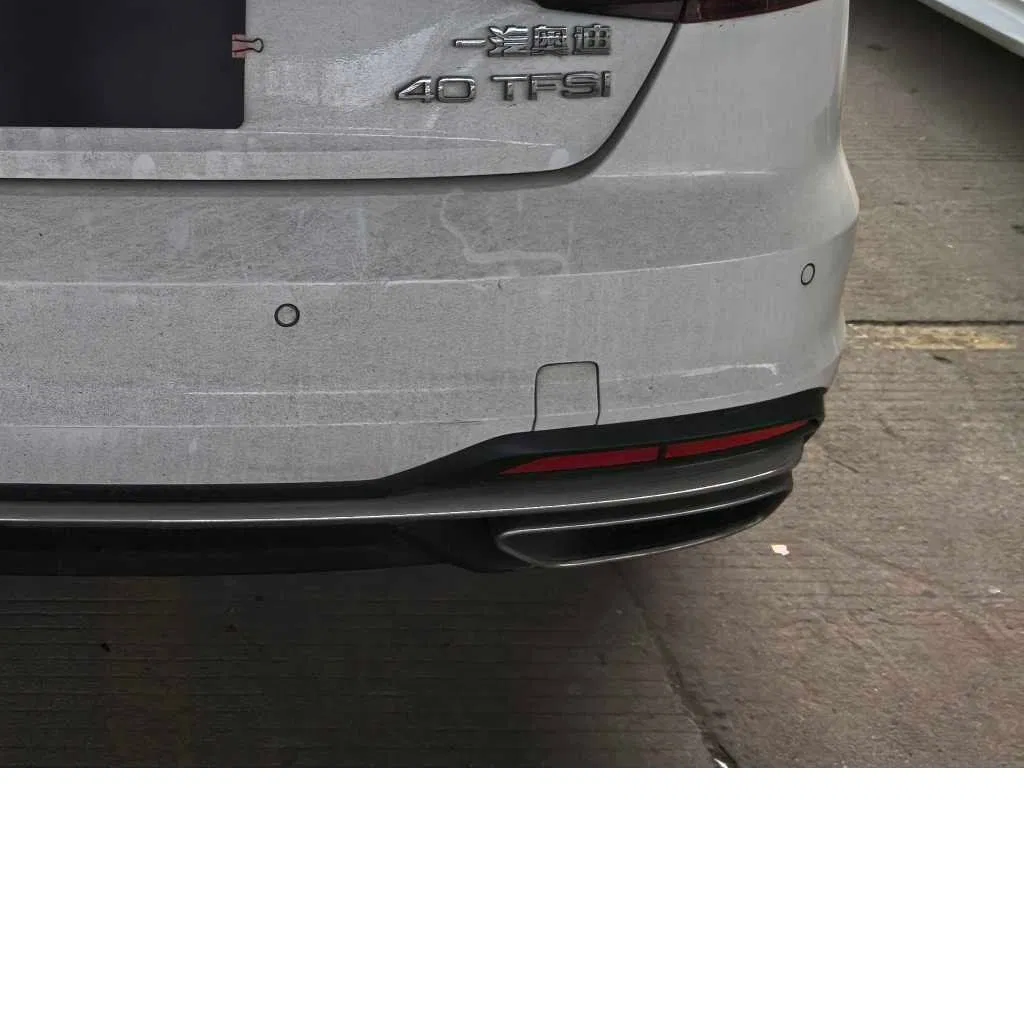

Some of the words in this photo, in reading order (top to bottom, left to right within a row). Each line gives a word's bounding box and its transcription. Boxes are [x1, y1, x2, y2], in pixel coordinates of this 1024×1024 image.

[452, 24, 612, 57] 一汽奥迪
[395, 76, 477, 103] 40
